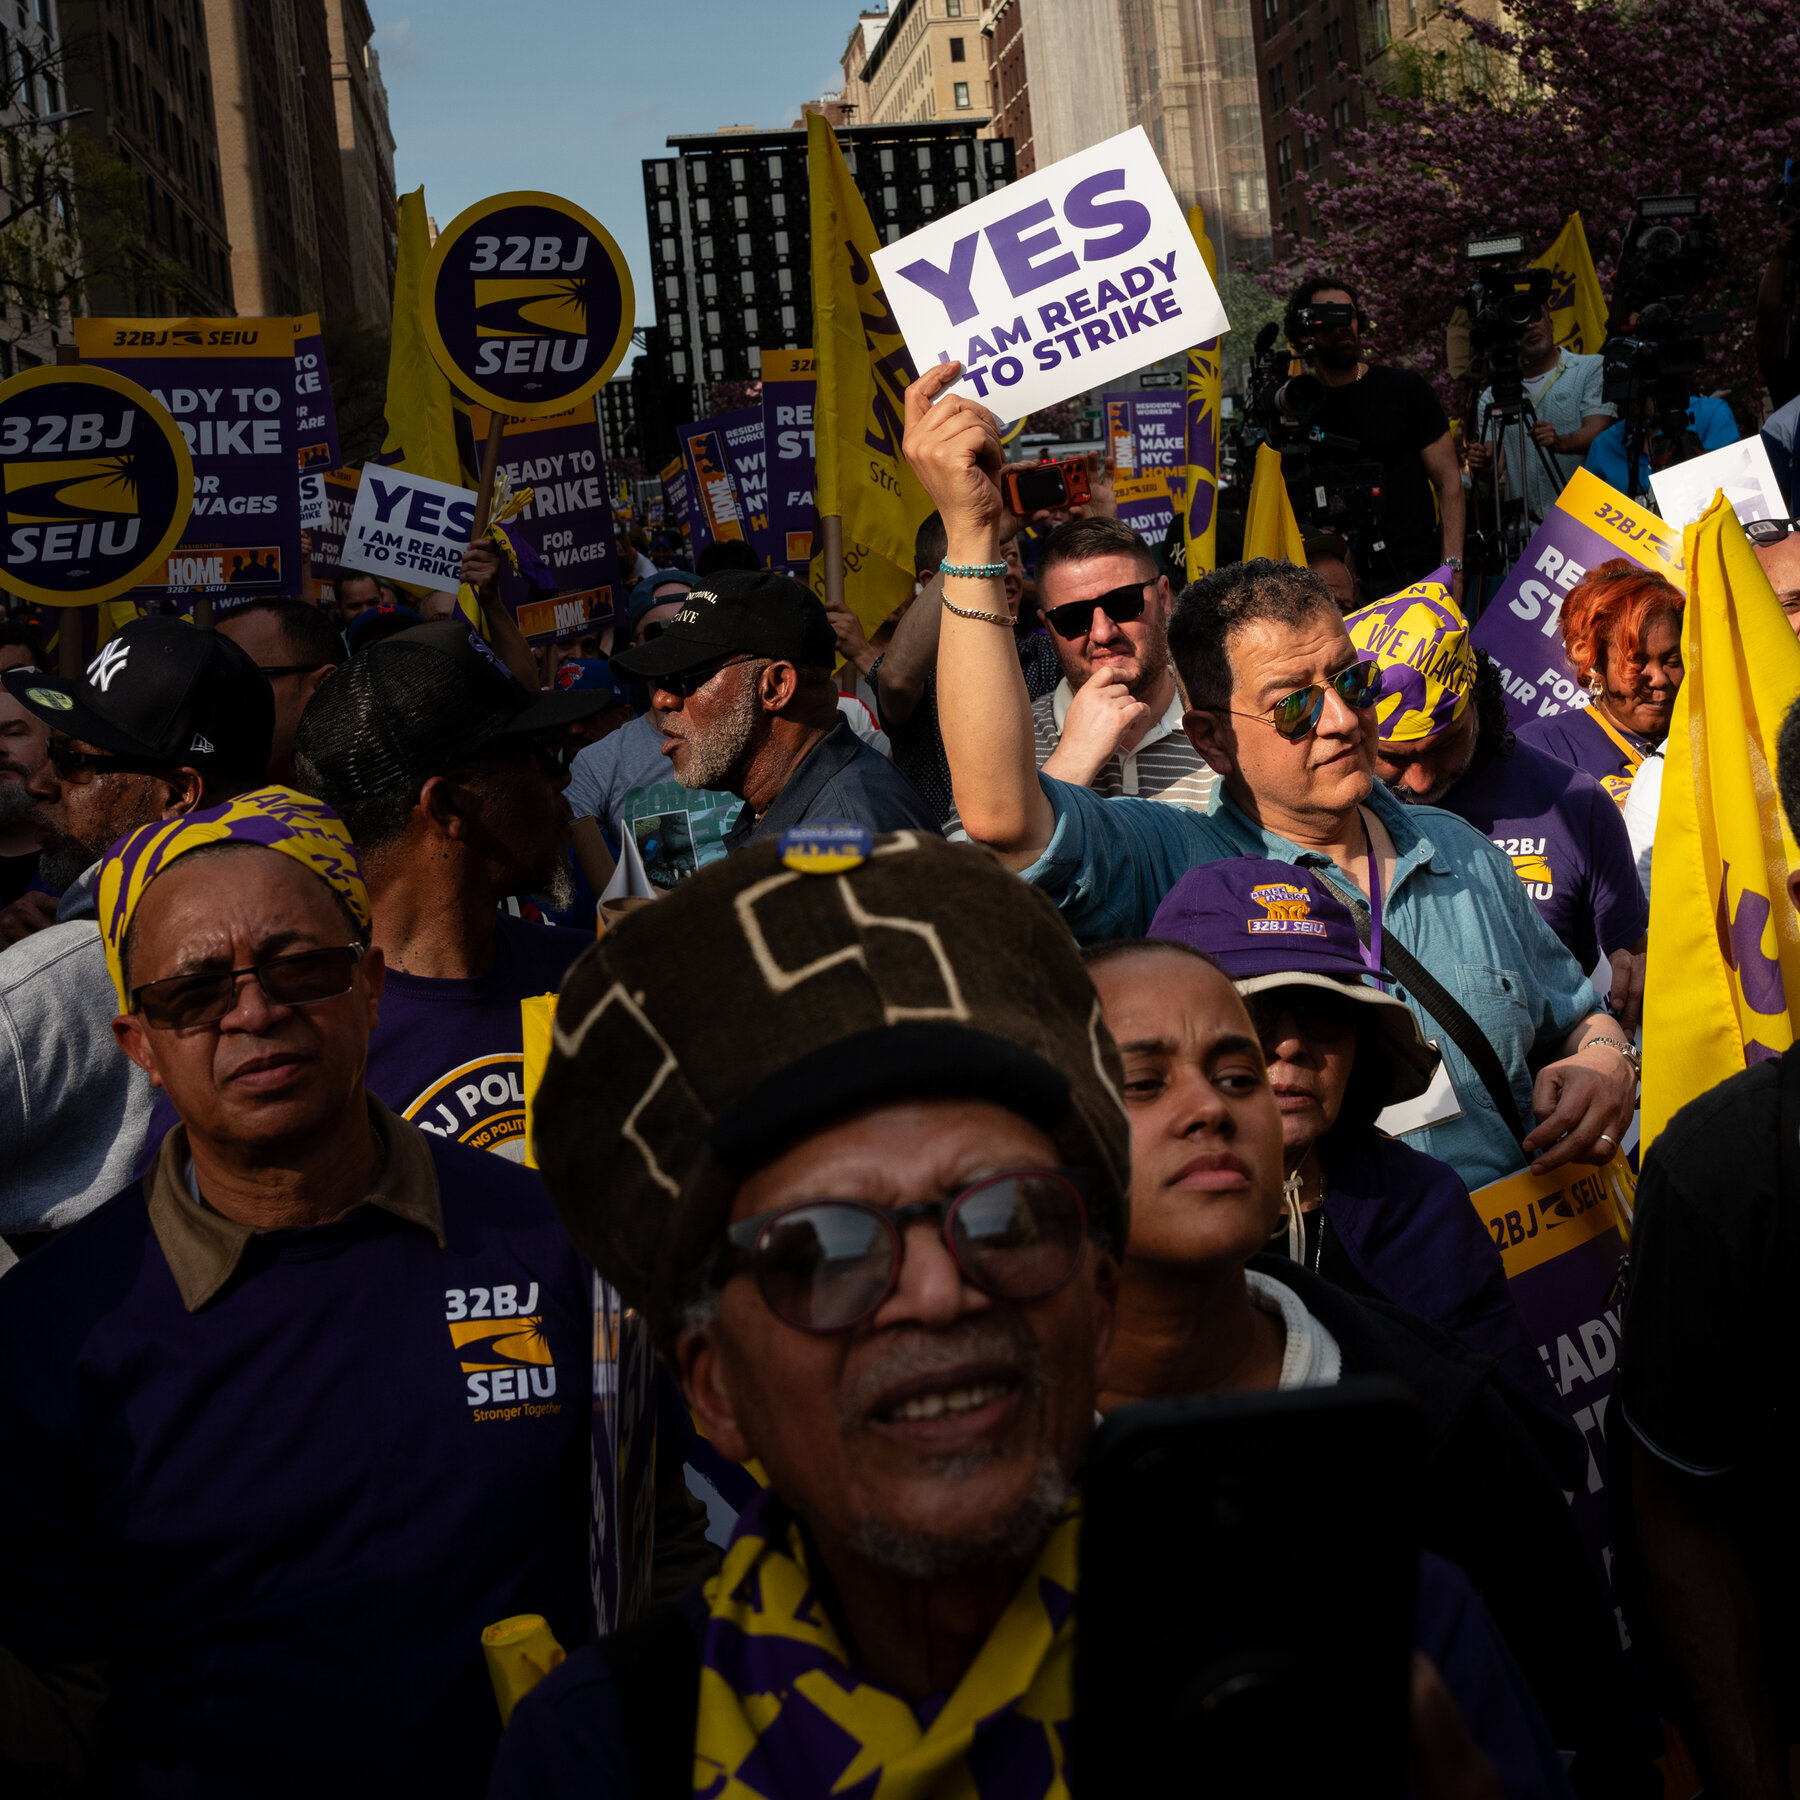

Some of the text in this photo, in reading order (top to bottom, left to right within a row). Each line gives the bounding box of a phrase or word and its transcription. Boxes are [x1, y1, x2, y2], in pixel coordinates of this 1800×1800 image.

[469, 235, 589, 272] 32BJ
[895, 168, 1152, 327] YES
[967, 249, 1177, 367] AM READY
[113, 331, 258, 346] 32BJ SEIU
[961, 288, 1183, 399] TO STRIKE
[475, 338, 589, 375] SEIU
[150, 388, 224, 414] ADY
[231, 387, 281, 413] TO
[0, 410, 136, 455] 32BJ
[181, 419, 282, 456] RIKE
[1138, 423, 1166, 436] WE
[1139, 437, 1185, 450] MAKE
[568, 449, 596, 474] TO
[1114, 436, 1132, 469] HOME
[1141, 451, 1173, 465] NYC
[193, 475, 220, 494] OR
[1141, 466, 1187, 479] HOME
[300, 510, 321, 521] RIKE
[369, 478, 477, 543] YES
[706, 477, 737, 525] HOME
[1157, 511, 1173, 526] TO
[1594, 502, 1647, 541] 32BJ
[7, 517, 142, 565] SEIU
[358, 526, 366, 540] I
[369, 530, 403, 549] AM
[542, 529, 574, 552] FOR
[363, 543, 390, 562] TO
[553, 541, 607, 568] WAGES
[168, 557, 224, 585] HOME
[204, 585, 227, 593] SEIU
[553, 599, 586, 628] HOME
[86, 637, 131, 692] NY
[1366, 623, 1409, 658] WE
[1407, 638, 1467, 695] MAKE
[1536, 667, 1591, 710] FOR
[1251, 921, 1324, 933] 32BJ SEIU
[1490, 1173, 1607, 1252] 2BJ SEIU
[445, 1282, 539, 1321] 32BJ
[466, 1366, 557, 1406] SEIU
[473, 1402, 562, 1423] Stronger Together
